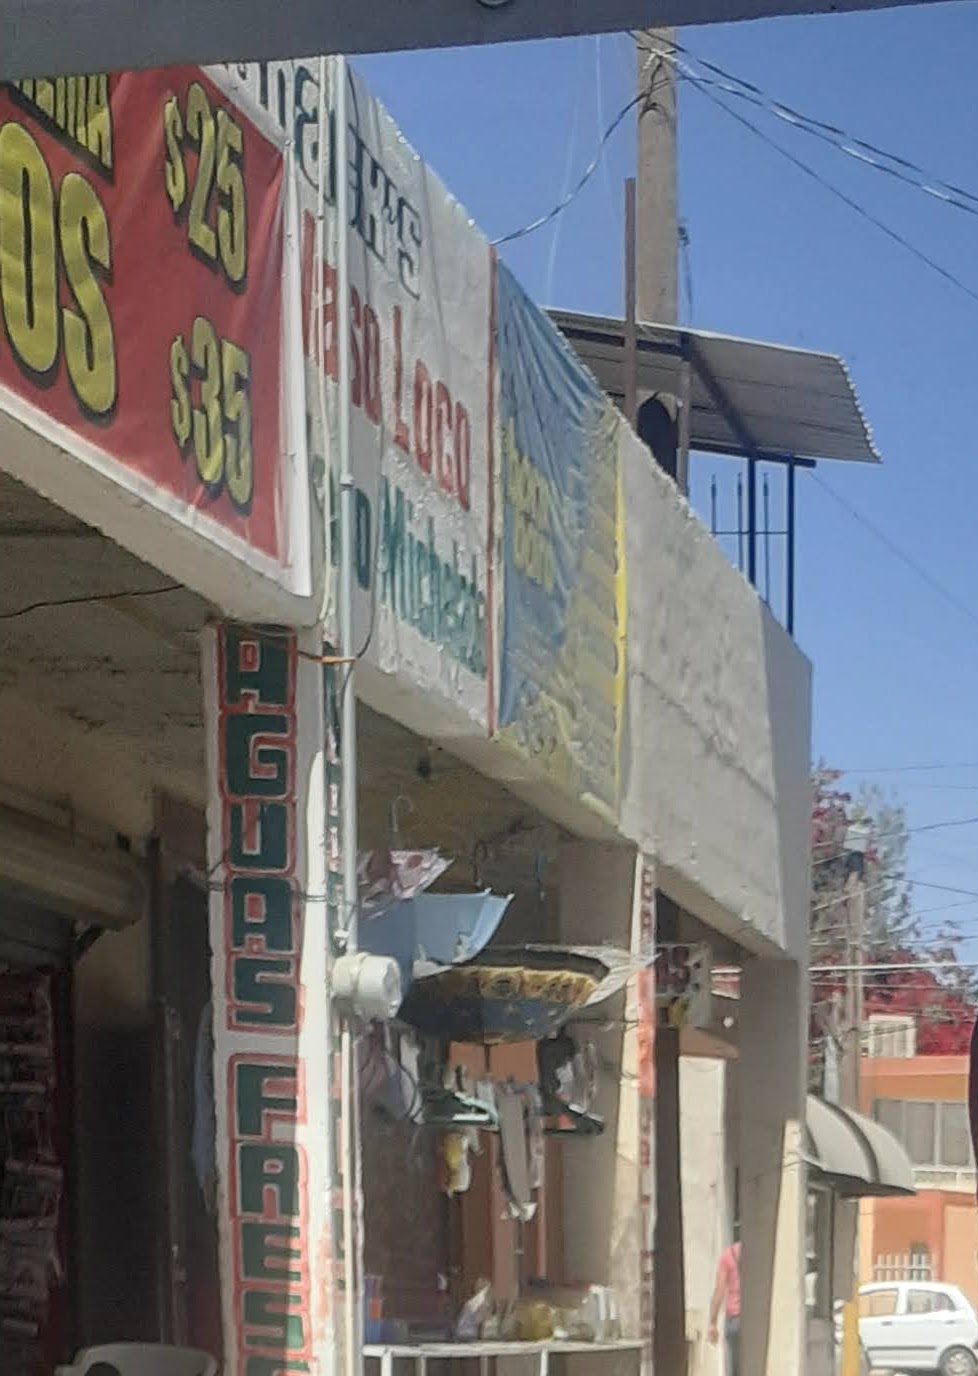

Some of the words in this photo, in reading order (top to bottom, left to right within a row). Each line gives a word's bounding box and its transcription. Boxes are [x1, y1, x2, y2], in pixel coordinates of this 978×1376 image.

[163, 82, 249, 292] $25
[171, 316, 253, 515] $35
[219, 626, 301, 1034] AGUAS
